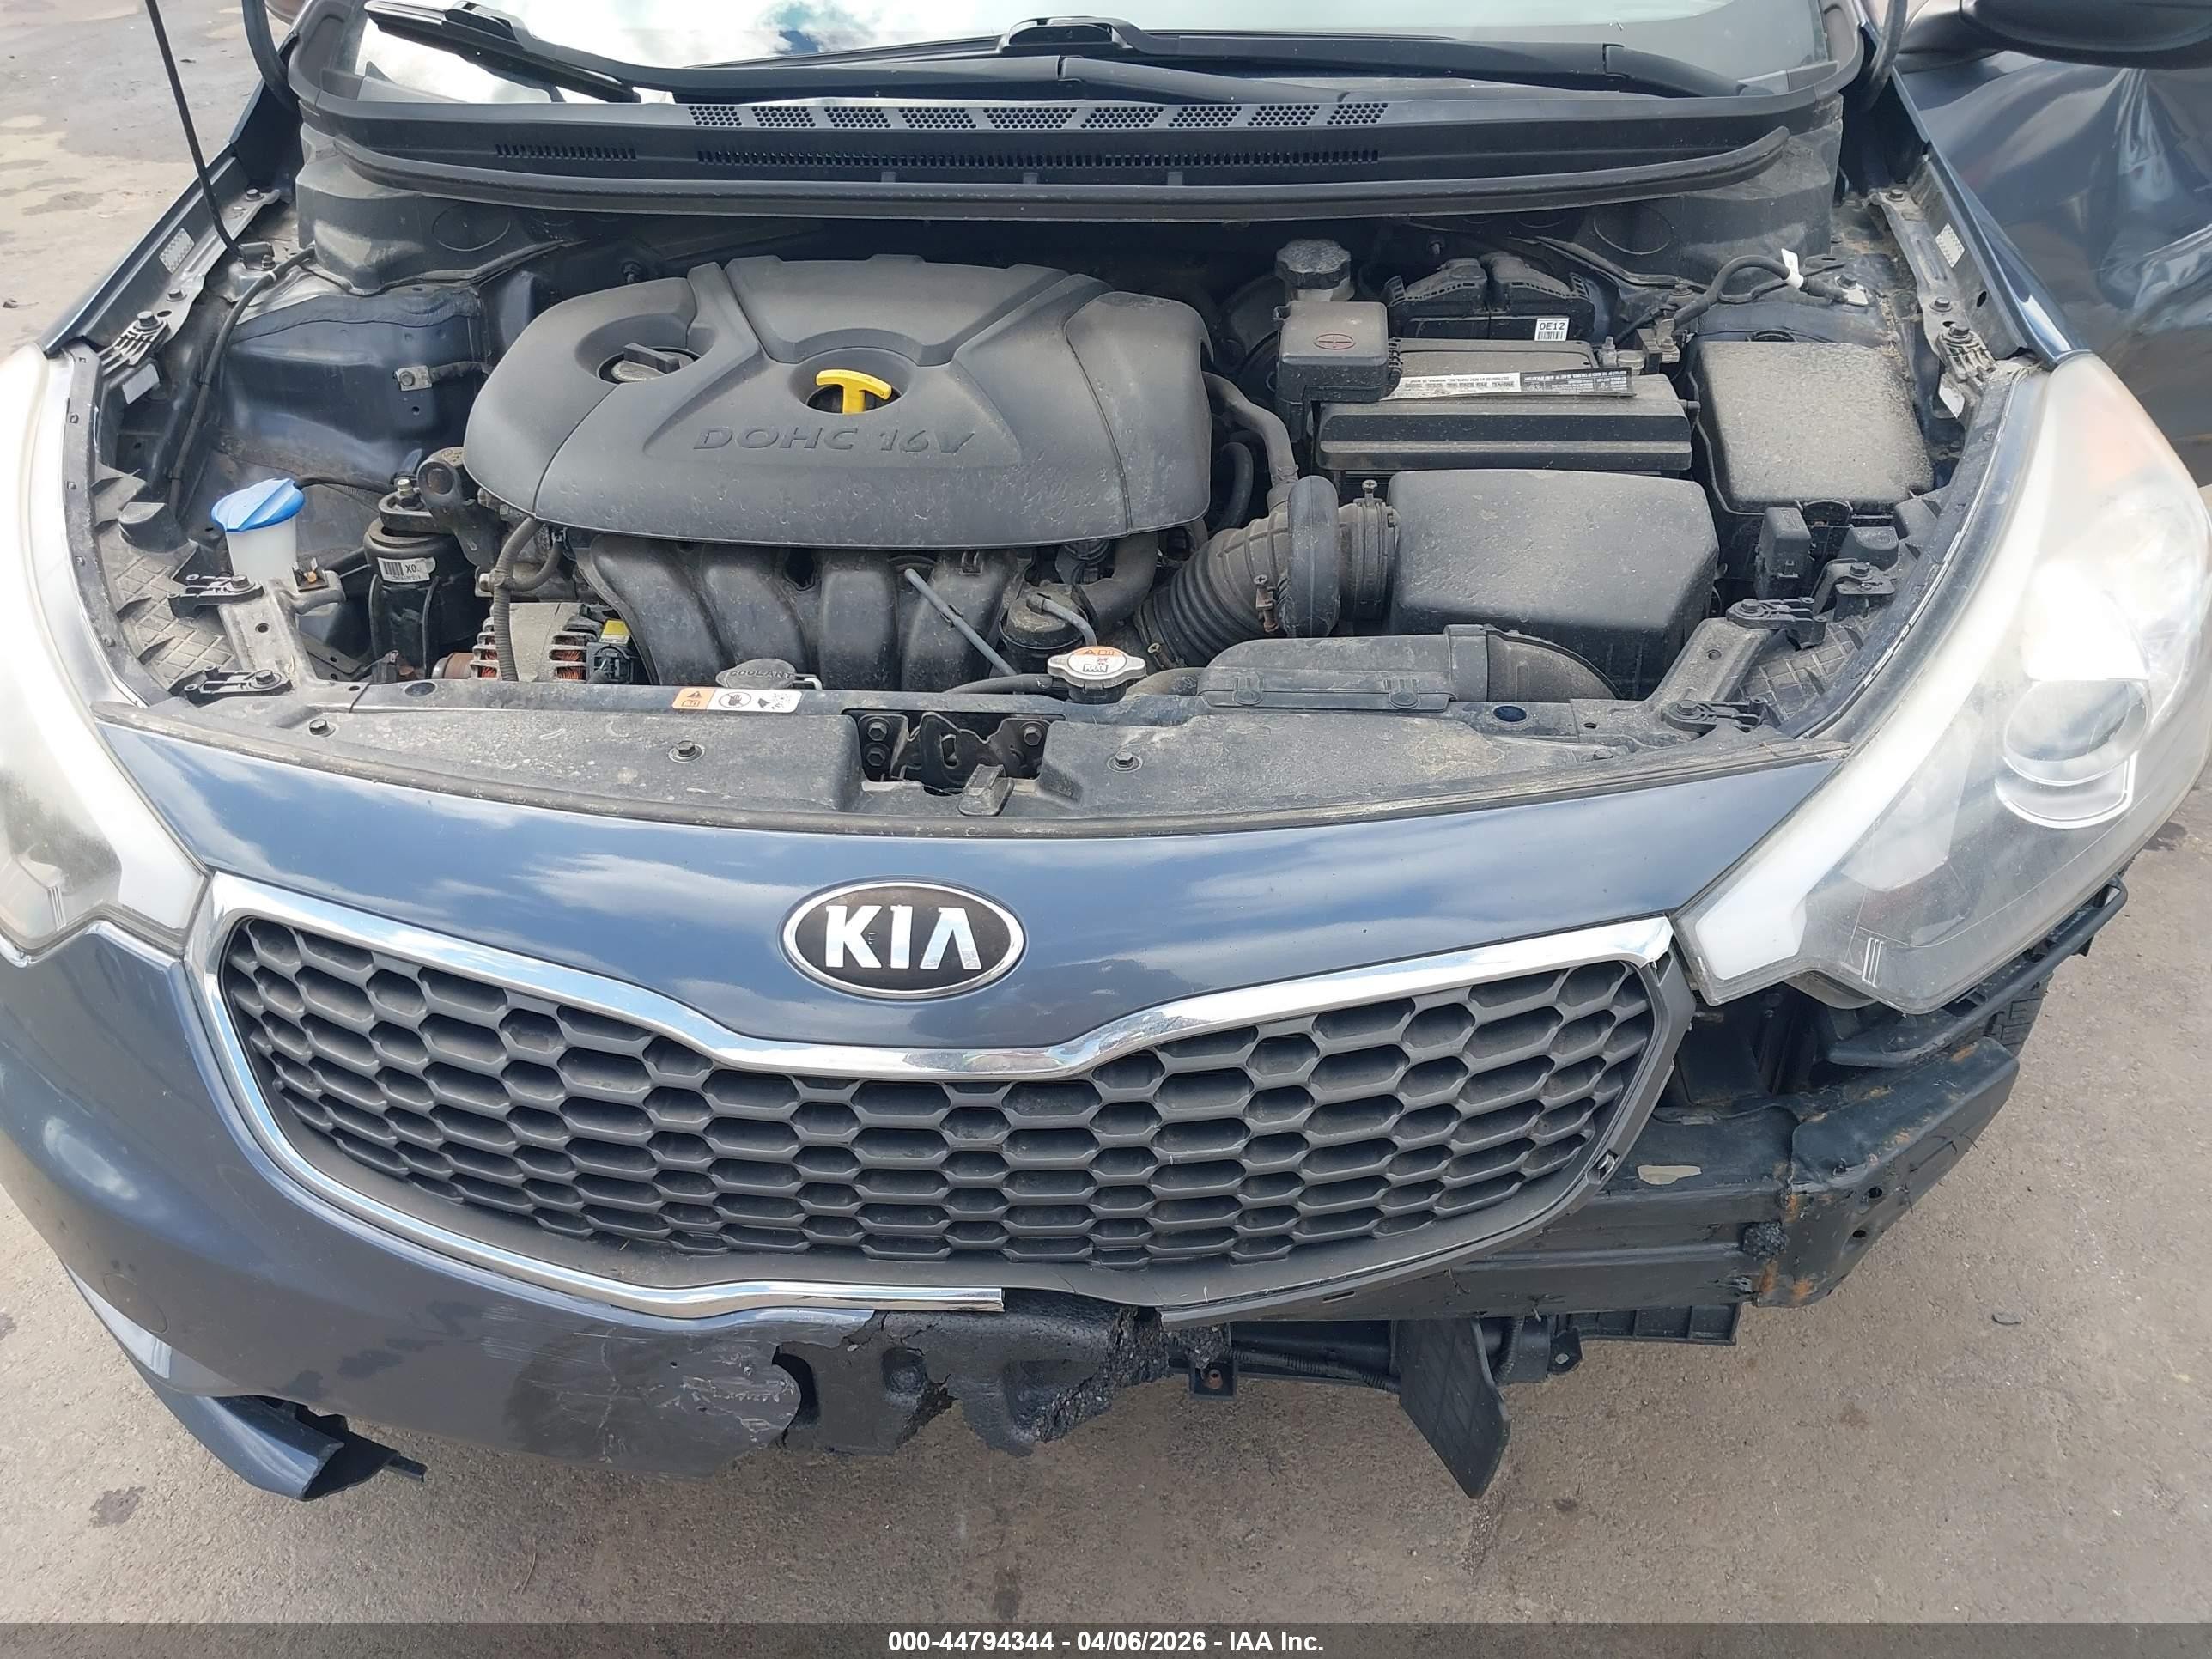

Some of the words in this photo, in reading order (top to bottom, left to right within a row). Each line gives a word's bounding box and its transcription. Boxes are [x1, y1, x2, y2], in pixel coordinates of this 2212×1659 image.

[693, 428, 858, 450] DOHC
[878, 429, 975, 454] 16V
[729, 669, 794, 681] COOLANT
[825, 904, 982, 969] KIA
